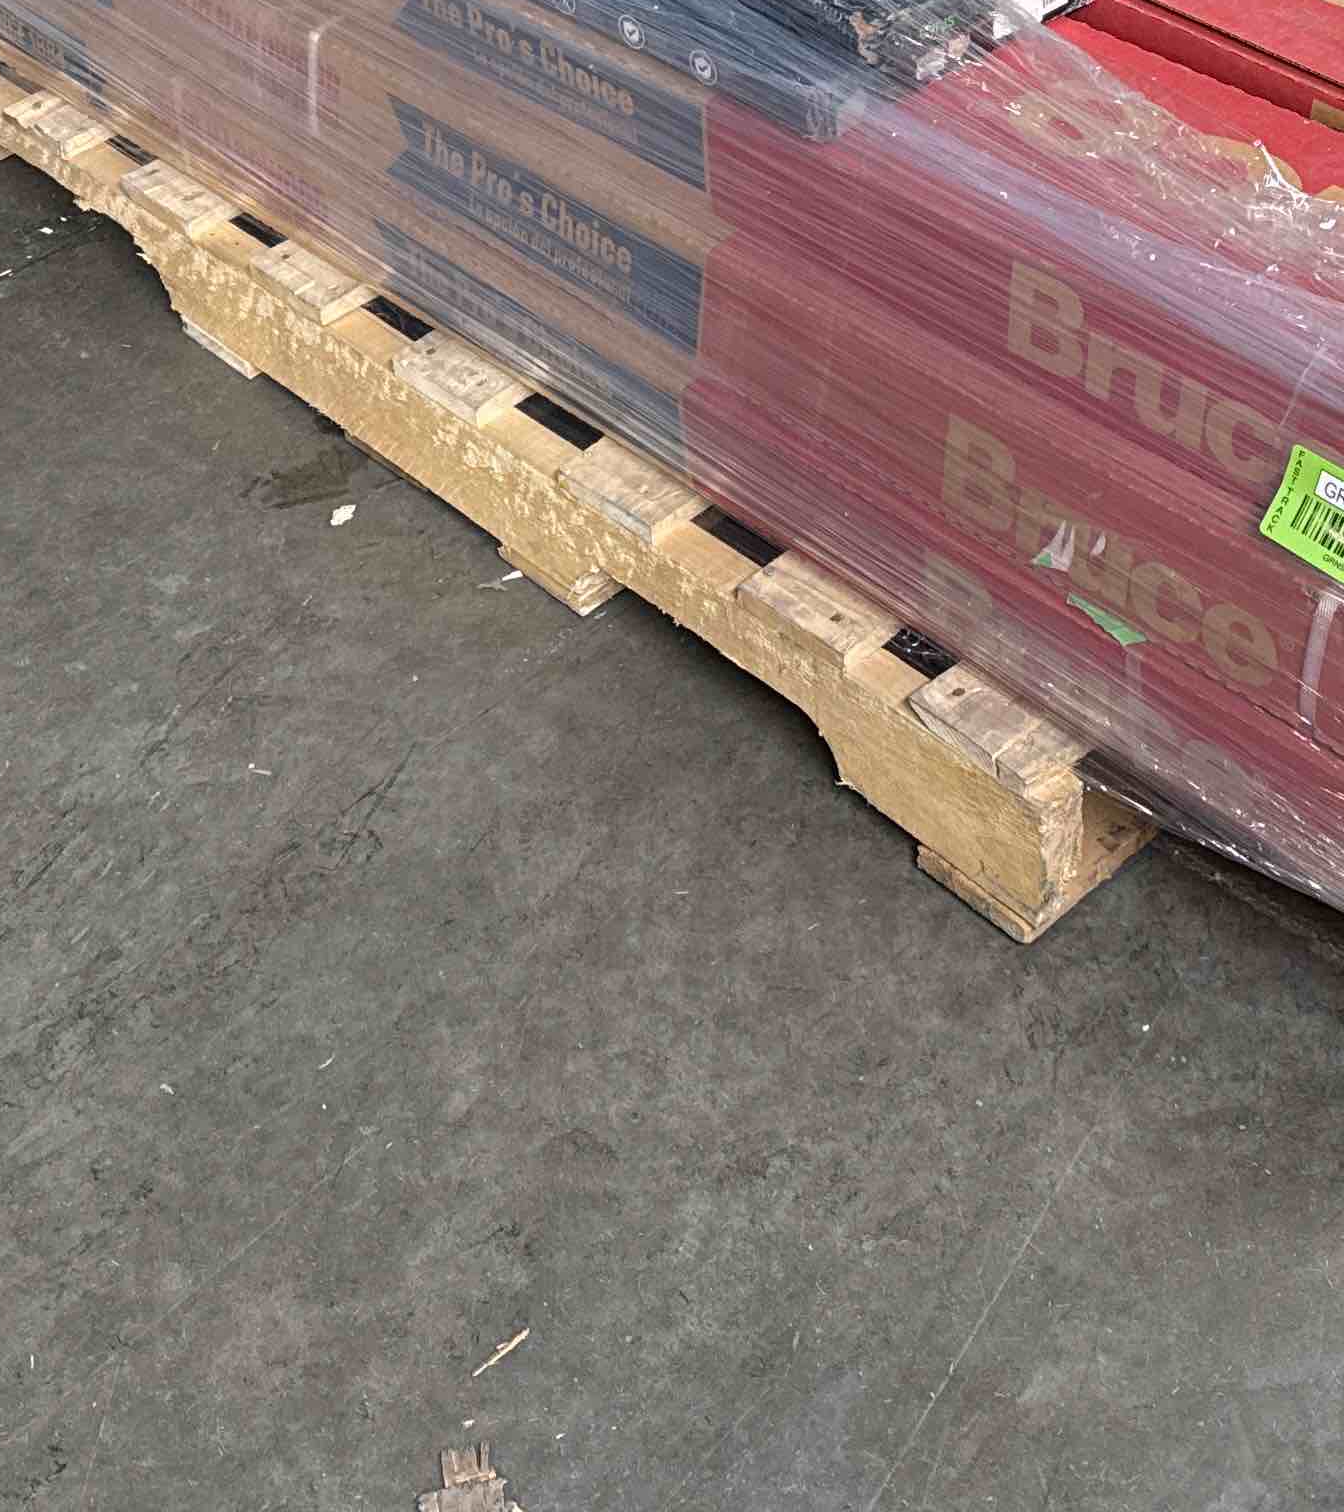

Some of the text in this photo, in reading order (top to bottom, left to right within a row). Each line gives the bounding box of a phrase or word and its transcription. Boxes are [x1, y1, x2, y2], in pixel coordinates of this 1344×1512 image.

[422, 118, 465, 178] The
[540, 192, 633, 274] Choice
[1008, 261, 1316, 486] Bruc
[943, 414, 1279, 689] Bruce
